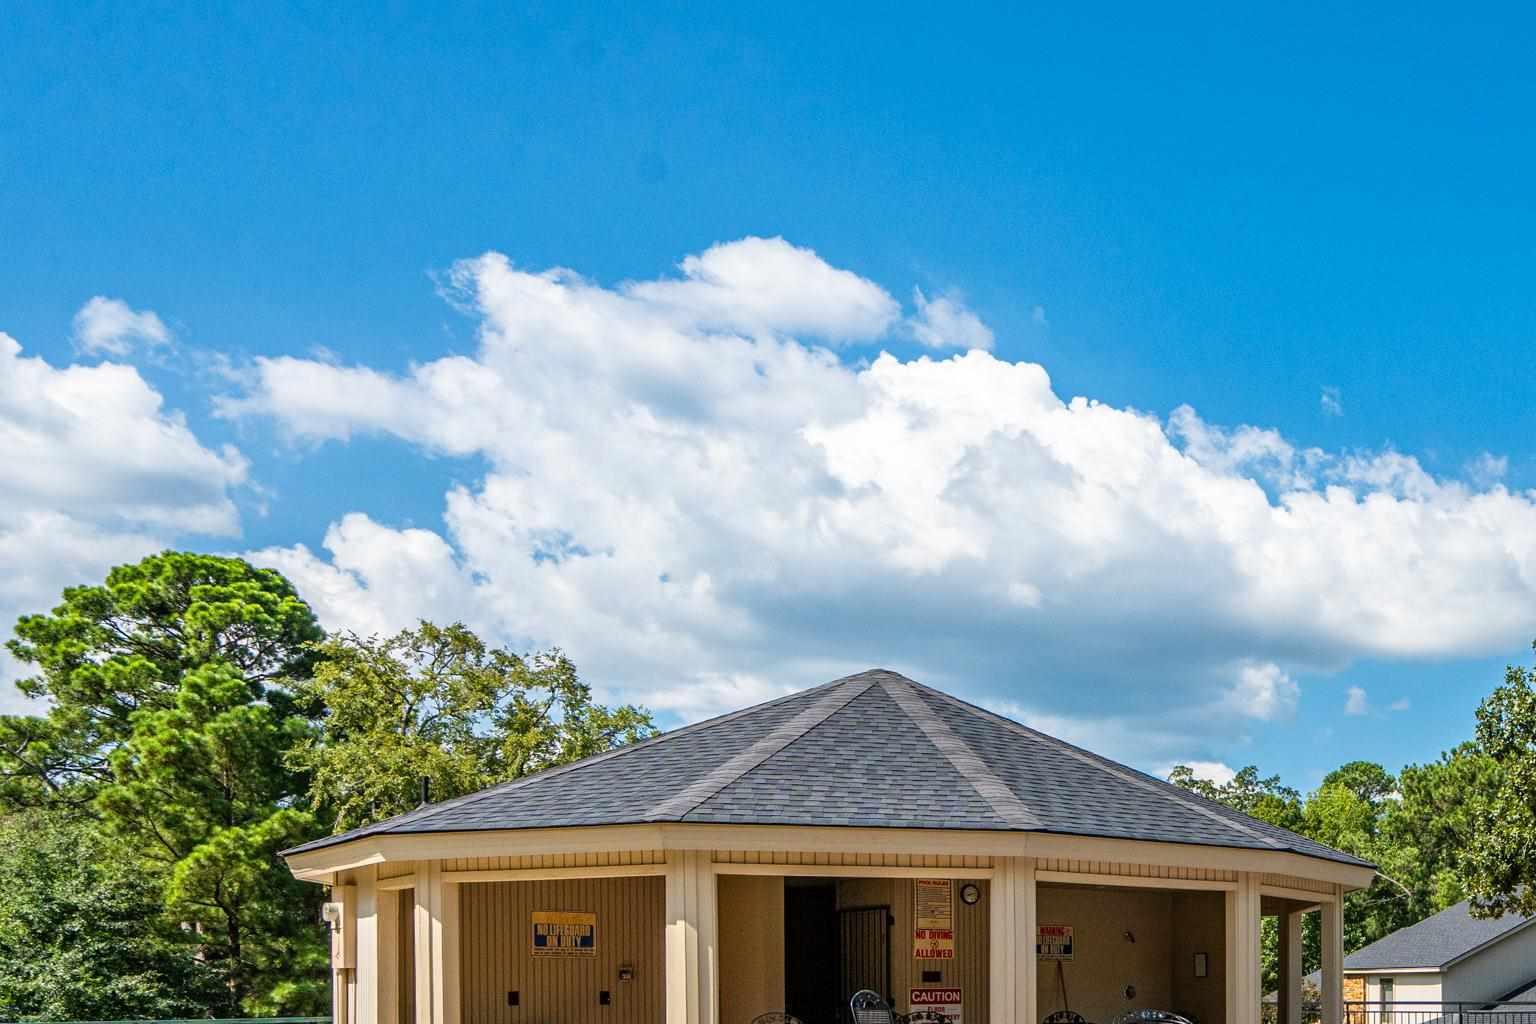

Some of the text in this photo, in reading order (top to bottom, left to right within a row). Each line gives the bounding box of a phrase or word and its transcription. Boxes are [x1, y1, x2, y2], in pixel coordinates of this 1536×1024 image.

[915, 931, 953, 940] NO DIVING
[560, 936, 582, 947] DUTY
[915, 949, 953, 958] ALLOWED
[911, 991, 960, 1002] CAUTION
